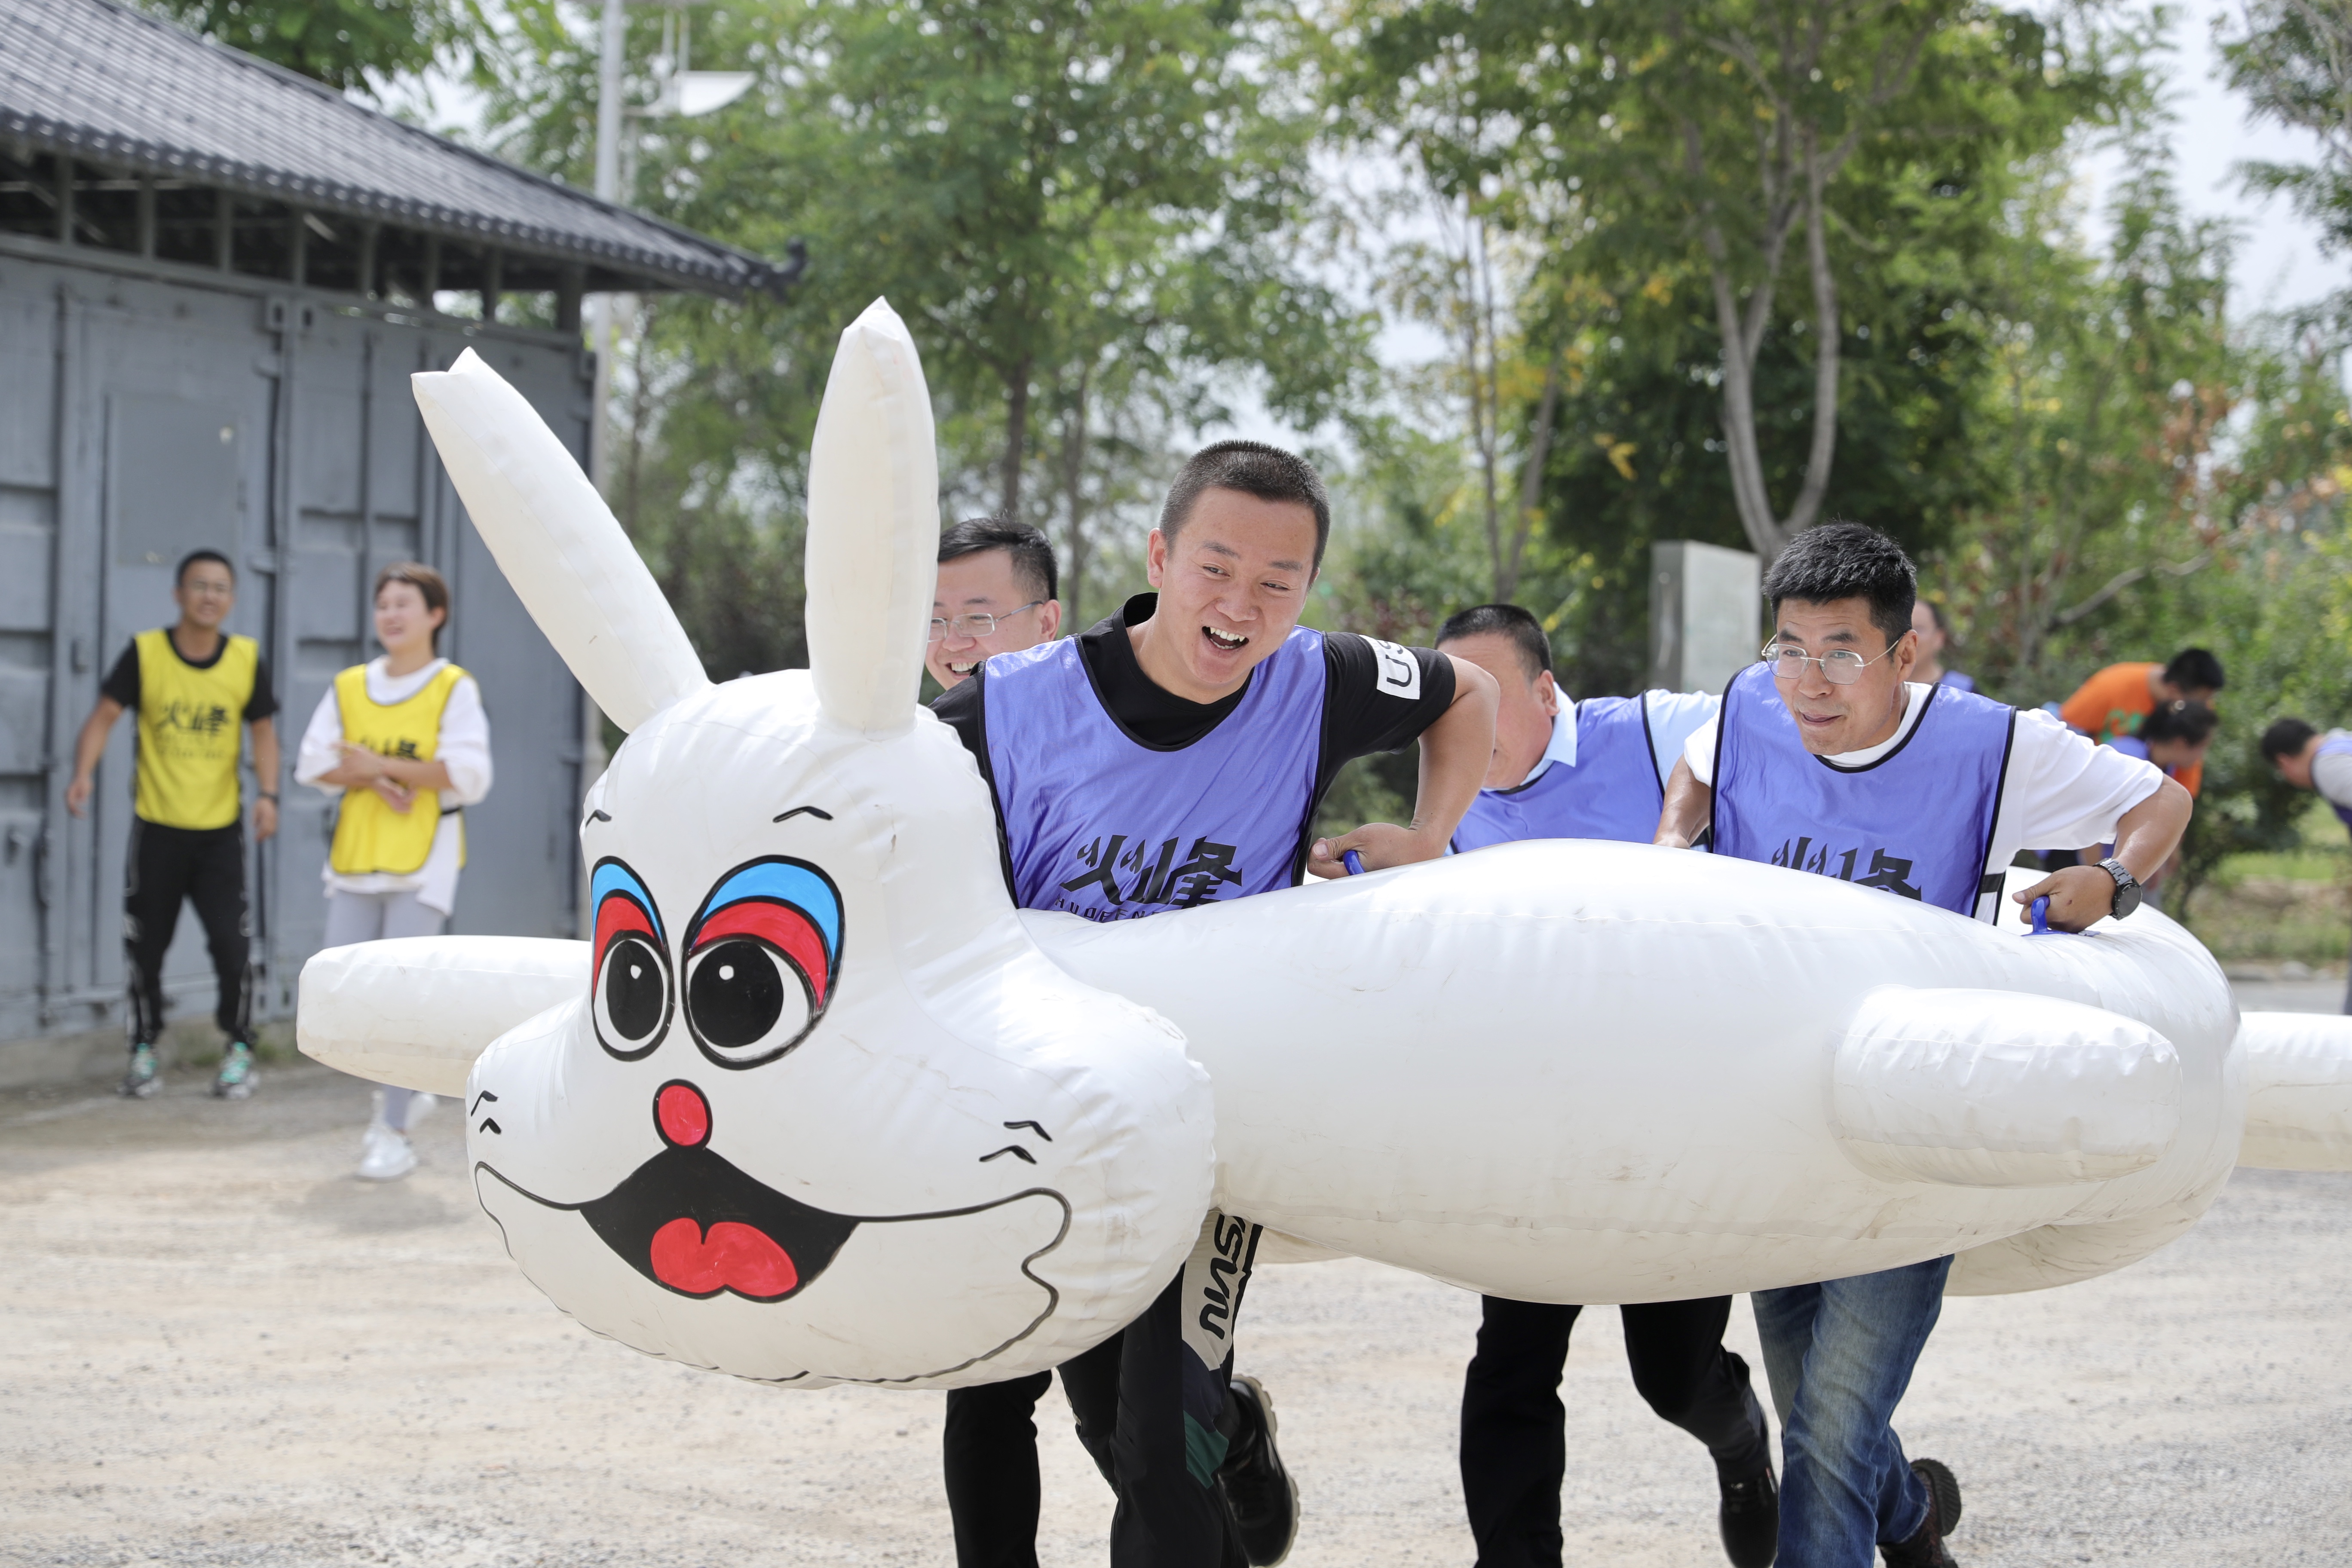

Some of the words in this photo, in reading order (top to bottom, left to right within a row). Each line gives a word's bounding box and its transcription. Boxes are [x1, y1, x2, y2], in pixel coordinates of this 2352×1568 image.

[1060, 835, 1242, 909] 火峰
[1054, 897, 1160, 922] HUOFEN
[1200, 1213, 1246, 1340] NAS
